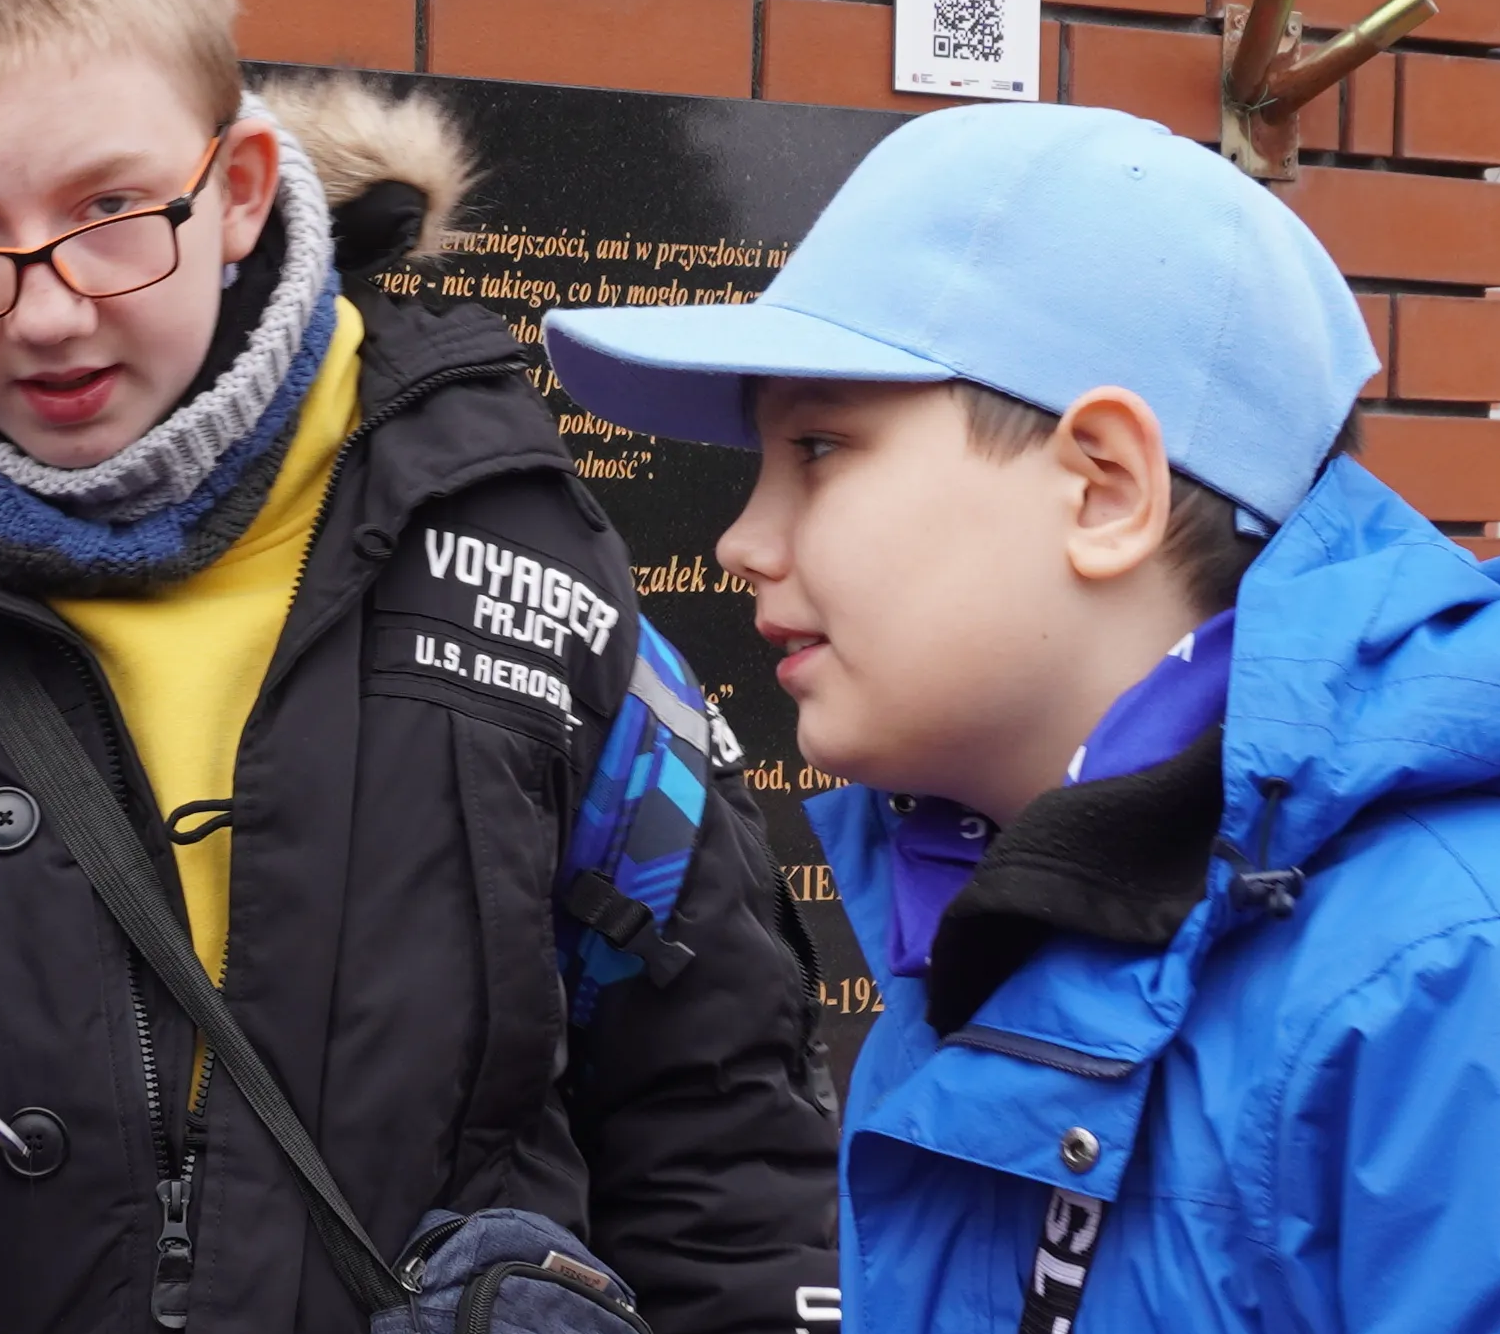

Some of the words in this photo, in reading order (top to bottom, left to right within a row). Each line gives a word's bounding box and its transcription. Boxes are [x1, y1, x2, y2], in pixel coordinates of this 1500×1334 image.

[596, 232, 631, 261] ani
[636, 240, 652, 261] w
[655, 237, 764, 272] przyszłości
[442, 268, 476, 297] nic
[480, 269, 562, 309] takiego,
[568, 281, 592, 304] co
[597, 274, 622, 308] by
[425, 528, 620, 656] VOYAGER
[473, 593, 572, 657] PRJCT
[415, 634, 469, 678] U.S.
